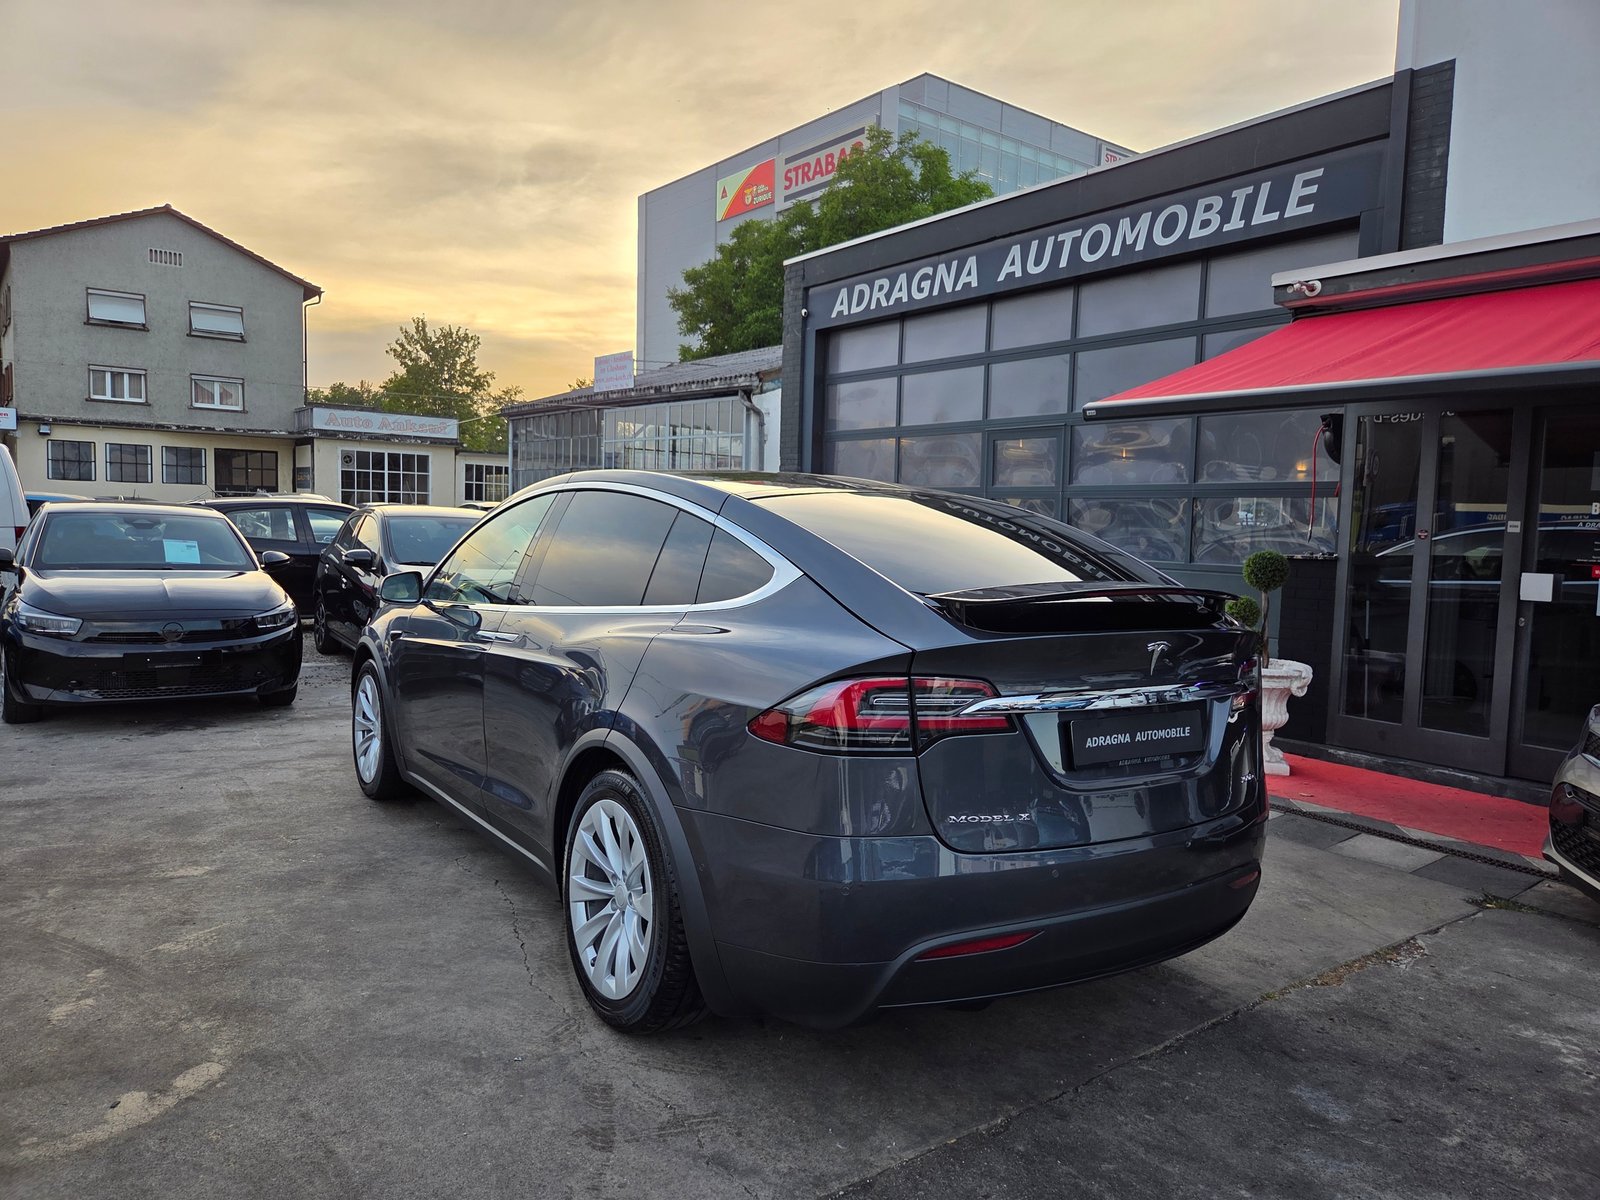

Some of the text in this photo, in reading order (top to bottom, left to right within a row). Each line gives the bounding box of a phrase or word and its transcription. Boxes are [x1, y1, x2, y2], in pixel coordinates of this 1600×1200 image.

[831, 167, 1324, 318] ADRAGNA AUTOMOBILE
[325, 412, 448, 435] Auto Ankauf
[1086, 726, 1191, 748] ADRAGNA AUTOMOBILE
[949, 813, 1031, 823] MODEL X
